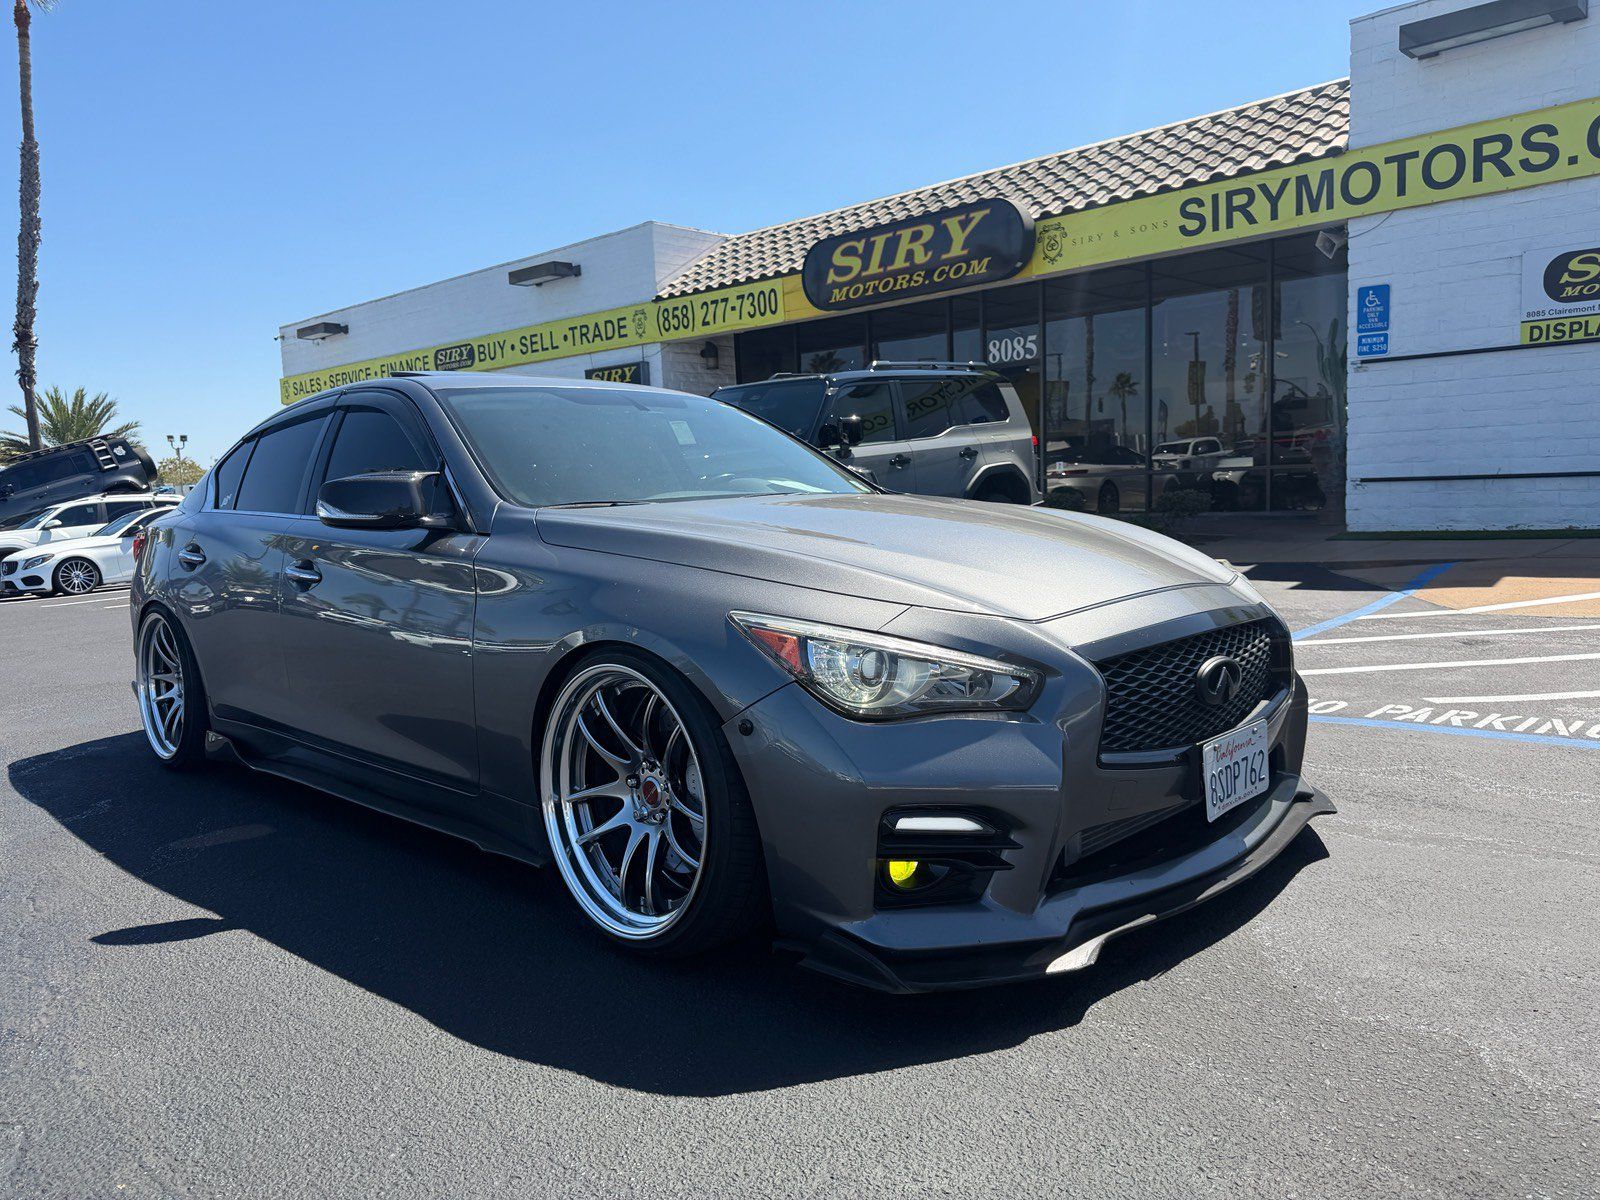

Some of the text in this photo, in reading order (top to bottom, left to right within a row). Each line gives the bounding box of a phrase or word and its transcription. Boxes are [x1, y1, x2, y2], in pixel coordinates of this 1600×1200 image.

[1179, 112, 1600, 237] SIRYMOTORS.
[826, 207, 991, 285] SIRY
[1071, 220, 1168, 247] SIRY & SONS
[828, 256, 992, 303] MOTORS.COM
[656, 288, 779, 337] (858) 277-7300
[1525, 309, 1547, 319] 8085
[1548, 305, 1596, 316] Clairemont
[436, 345, 471, 364] SIRY
[477, 316, 629, 363] BUY SELL TRADE
[988, 334, 1038, 364] 8085
[292, 354, 430, 397] SALES SERVICE FINANCE
[1214, 737, 1257, 763] California
[1210, 748, 1266, 808] 8SDP762
